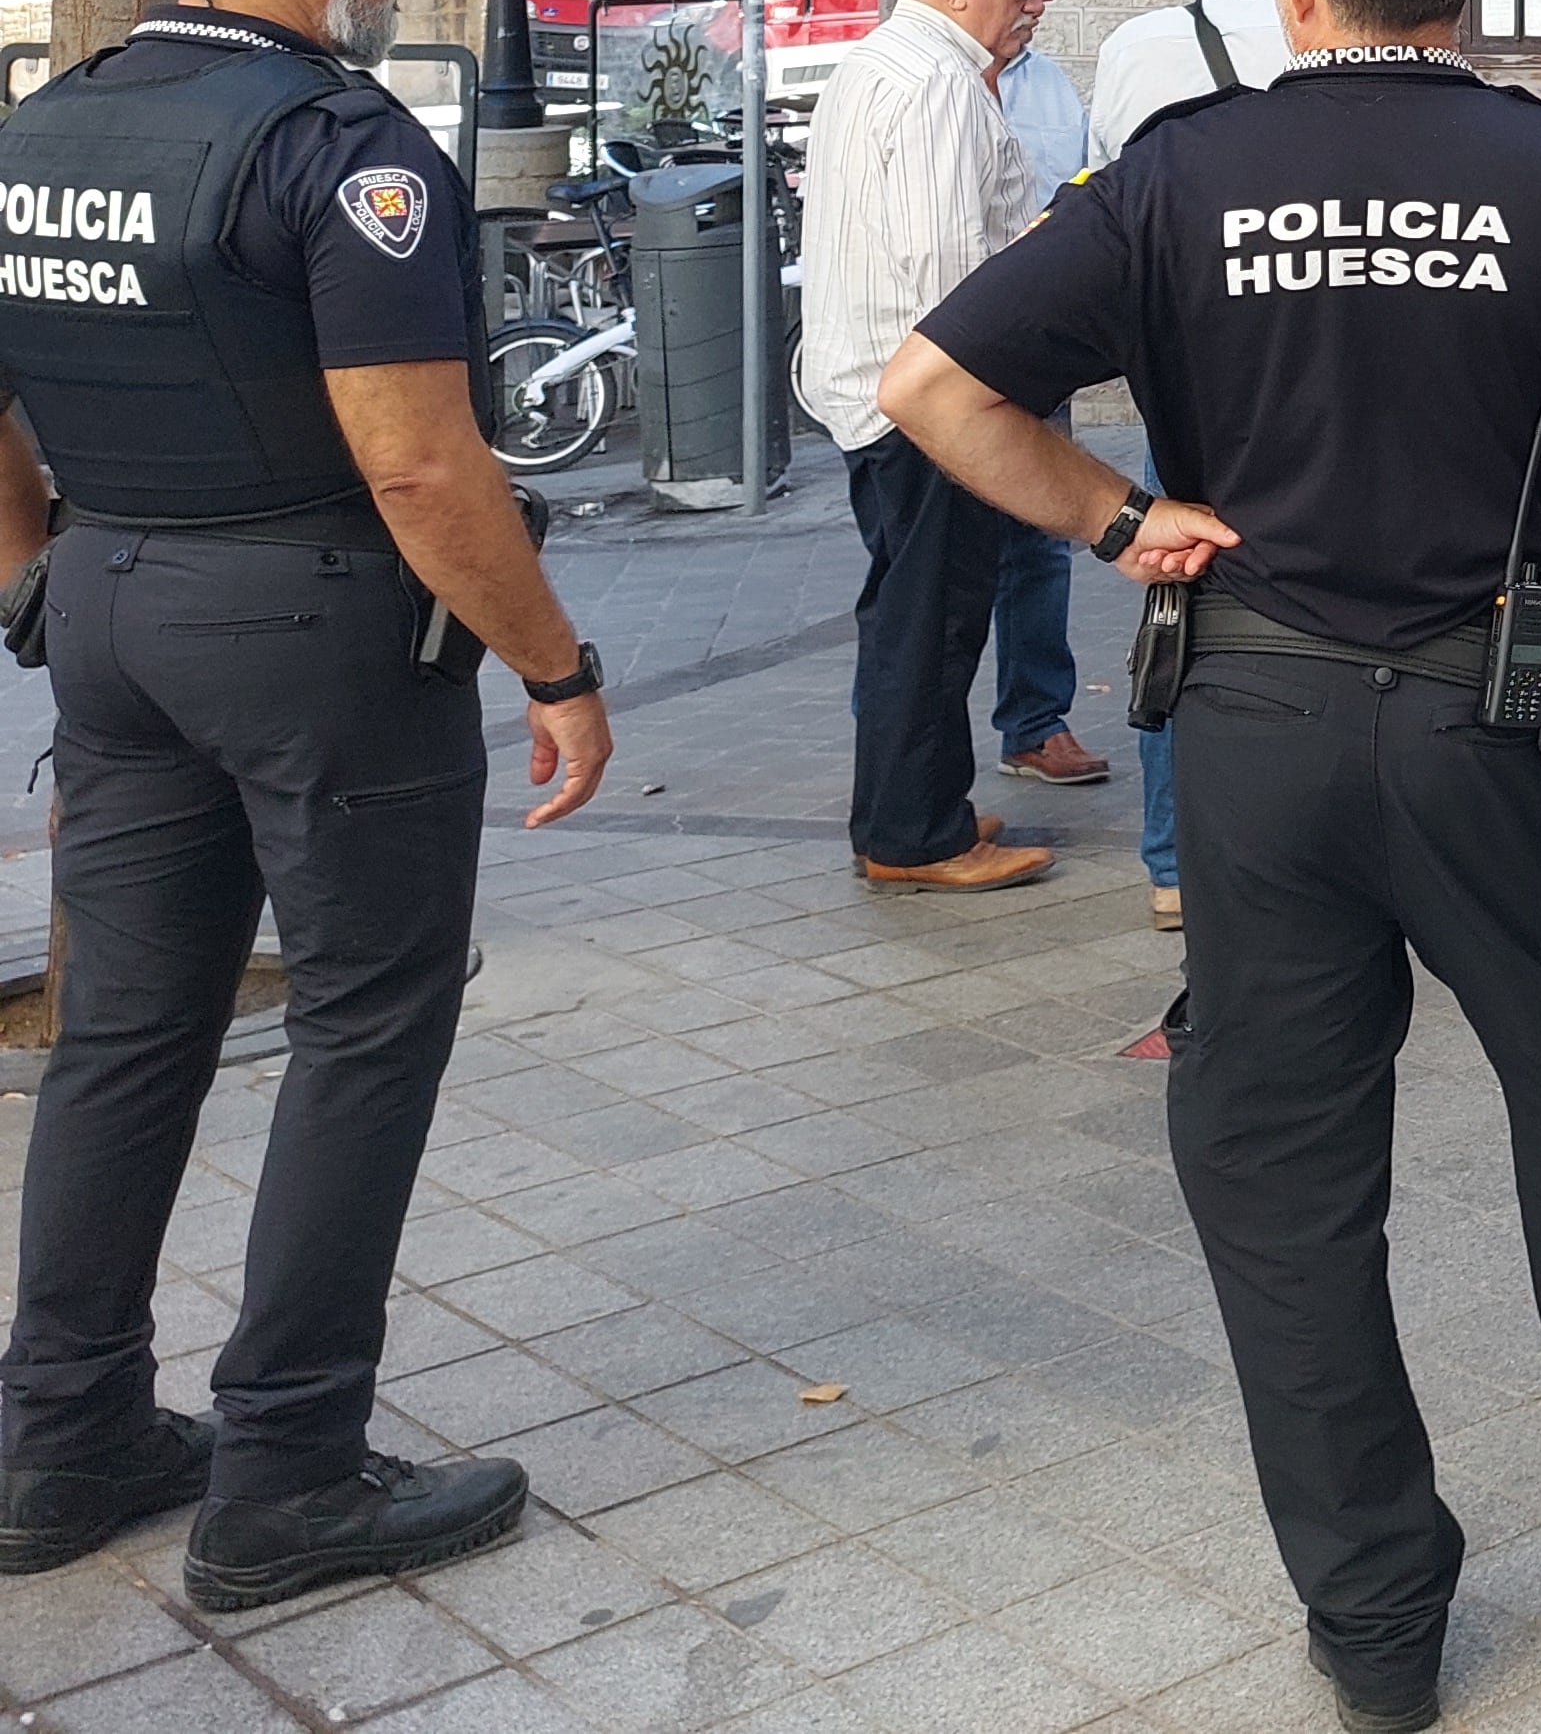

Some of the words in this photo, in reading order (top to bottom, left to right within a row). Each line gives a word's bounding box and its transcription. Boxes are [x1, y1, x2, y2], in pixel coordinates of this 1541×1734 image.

[1335, 46, 1419, 64] POLICIA
[358, 173, 409, 187] HUESCA
[350, 201, 386, 241] POLICIA
[410, 198, 423, 232] LOCAL
[1224, 199, 1511, 248] POLICIA
[1225, 247, 1509, 297] HUESCA
